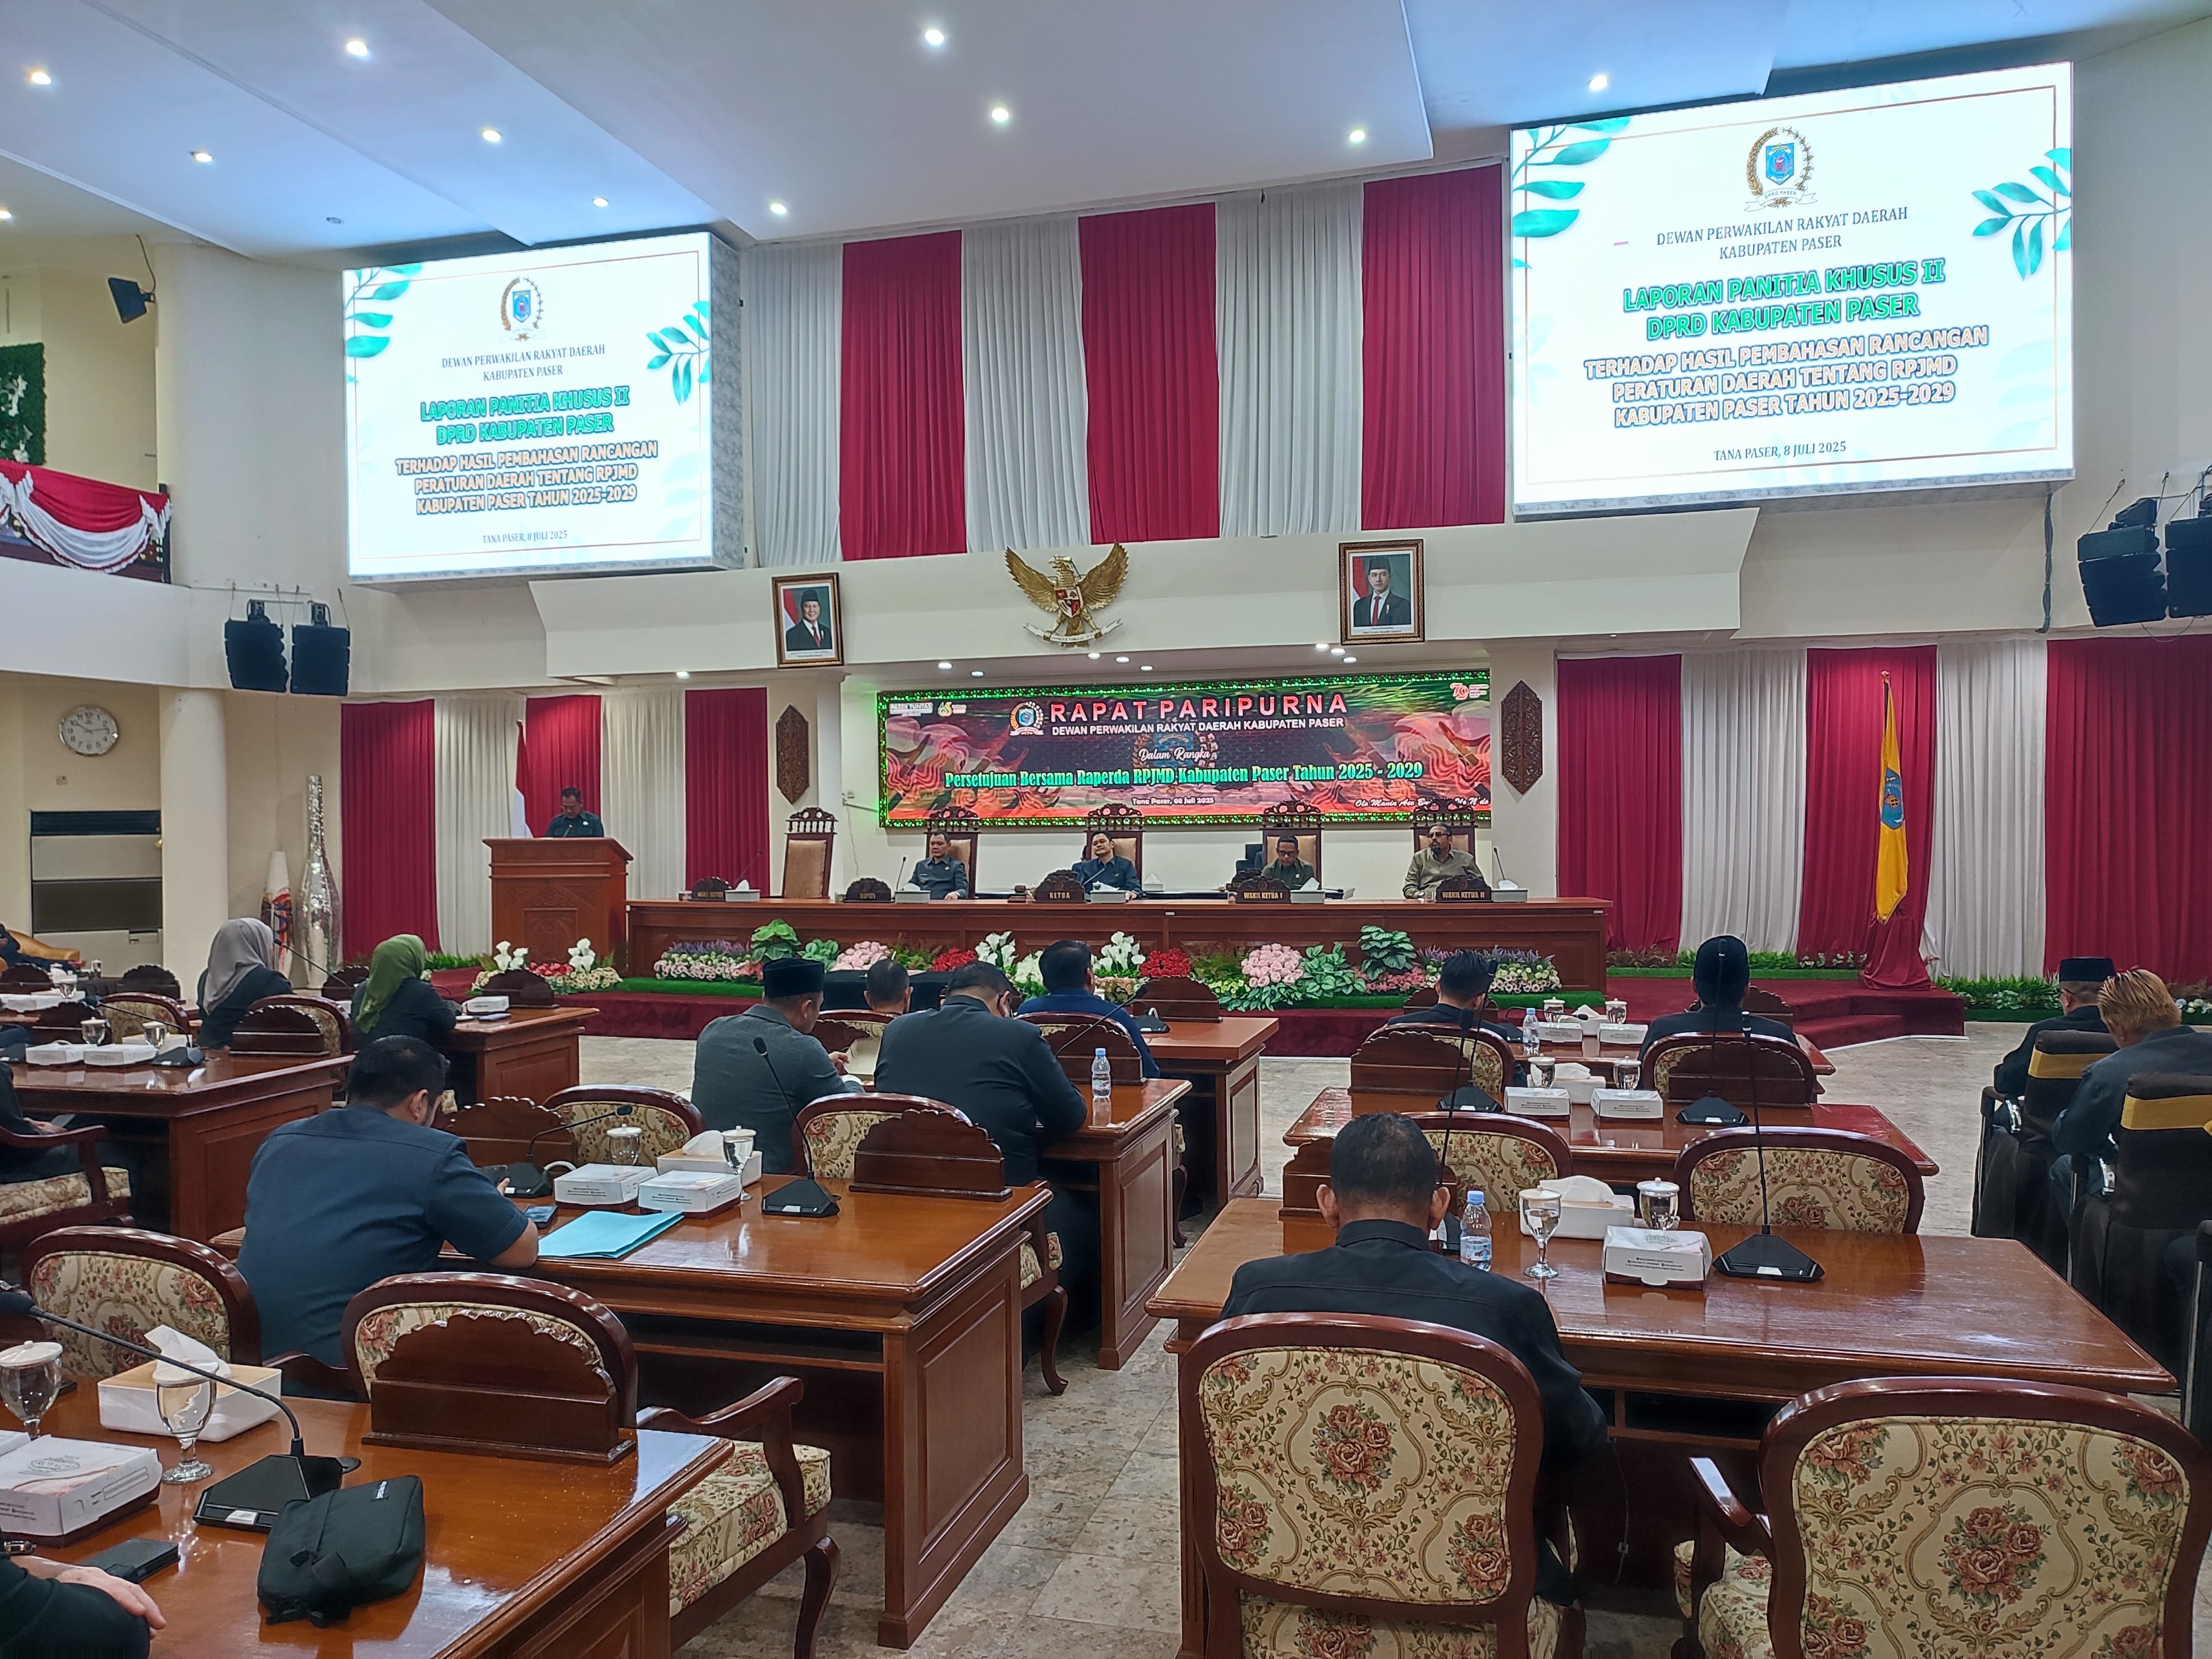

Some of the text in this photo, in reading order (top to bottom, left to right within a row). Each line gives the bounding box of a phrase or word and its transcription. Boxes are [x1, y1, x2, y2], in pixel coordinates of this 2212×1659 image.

[1657, 206, 1908, 246] DEWAN PERWAKILAN RAKYAT DAERAH
[1719, 234, 1842, 259] KABUPATEN PASER
[1624, 258, 1945, 312] LAPORAN PANITIA KHUSUS II
[1647, 293, 1919, 340] DPRD KABUPATEN PASER
[442, 343, 606, 368] DEWAN PERWAKILAN RAKYAT DAERAH
[1584, 325, 1988, 379] TERHADAP HASIL PEMBAHASAN RANCANGAN
[483, 364, 563, 382] KABUPATEN PASER
[1613, 354, 1957, 402] PERATURAN DAERAH TENTANG RPJMD
[421, 385, 630, 421] LAPORAN PANITIA KHUSUS II
[1615, 381, 1955, 428] KABUPATEN PASER TAHUN 2025-2029
[436, 412, 614, 445] DPRD KABUPATEN PASER
[395, 441, 658, 475] TERHADAP HASIL PEMBAHASAN RANCANGAN
[1714, 441, 1846, 461] TANA PASER, 8 JULI 2025
[415, 463, 638, 494] PERATURAN DAERAH TENTANG RPJMD
[416, 483, 638, 514] KABUPATEN PASER TAHUN 2025-2029
[483, 534, 501, 544] TANA
[502, 532, 526, 543] PASER,
[533, 531, 549, 543] JULI
[549, 530, 567, 540] 2025
[1051, 694, 1347, 723] RAPAT PARIPURNA
[1052, 718, 1344, 735] DEWAN PERWAKILAN RAKYAT DAERAH KABUPATEN PASER
[1138, 747, 1211, 762] Dalam Rangka
[945, 772, 1017, 789] Persetujuan
[1020, 771, 1073, 787] Bersama
[1077, 769, 1130, 787] Raperda
[1133, 768, 1175, 786] RPJMD
[1178, 766, 1249, 785] Kabupaten
[1251, 766, 1290, 782] Paser
[1293, 765, 1334, 780] Tahun
[1339, 763, 1373, 780] 2025
[1387, 761, 1423, 779] 2029
